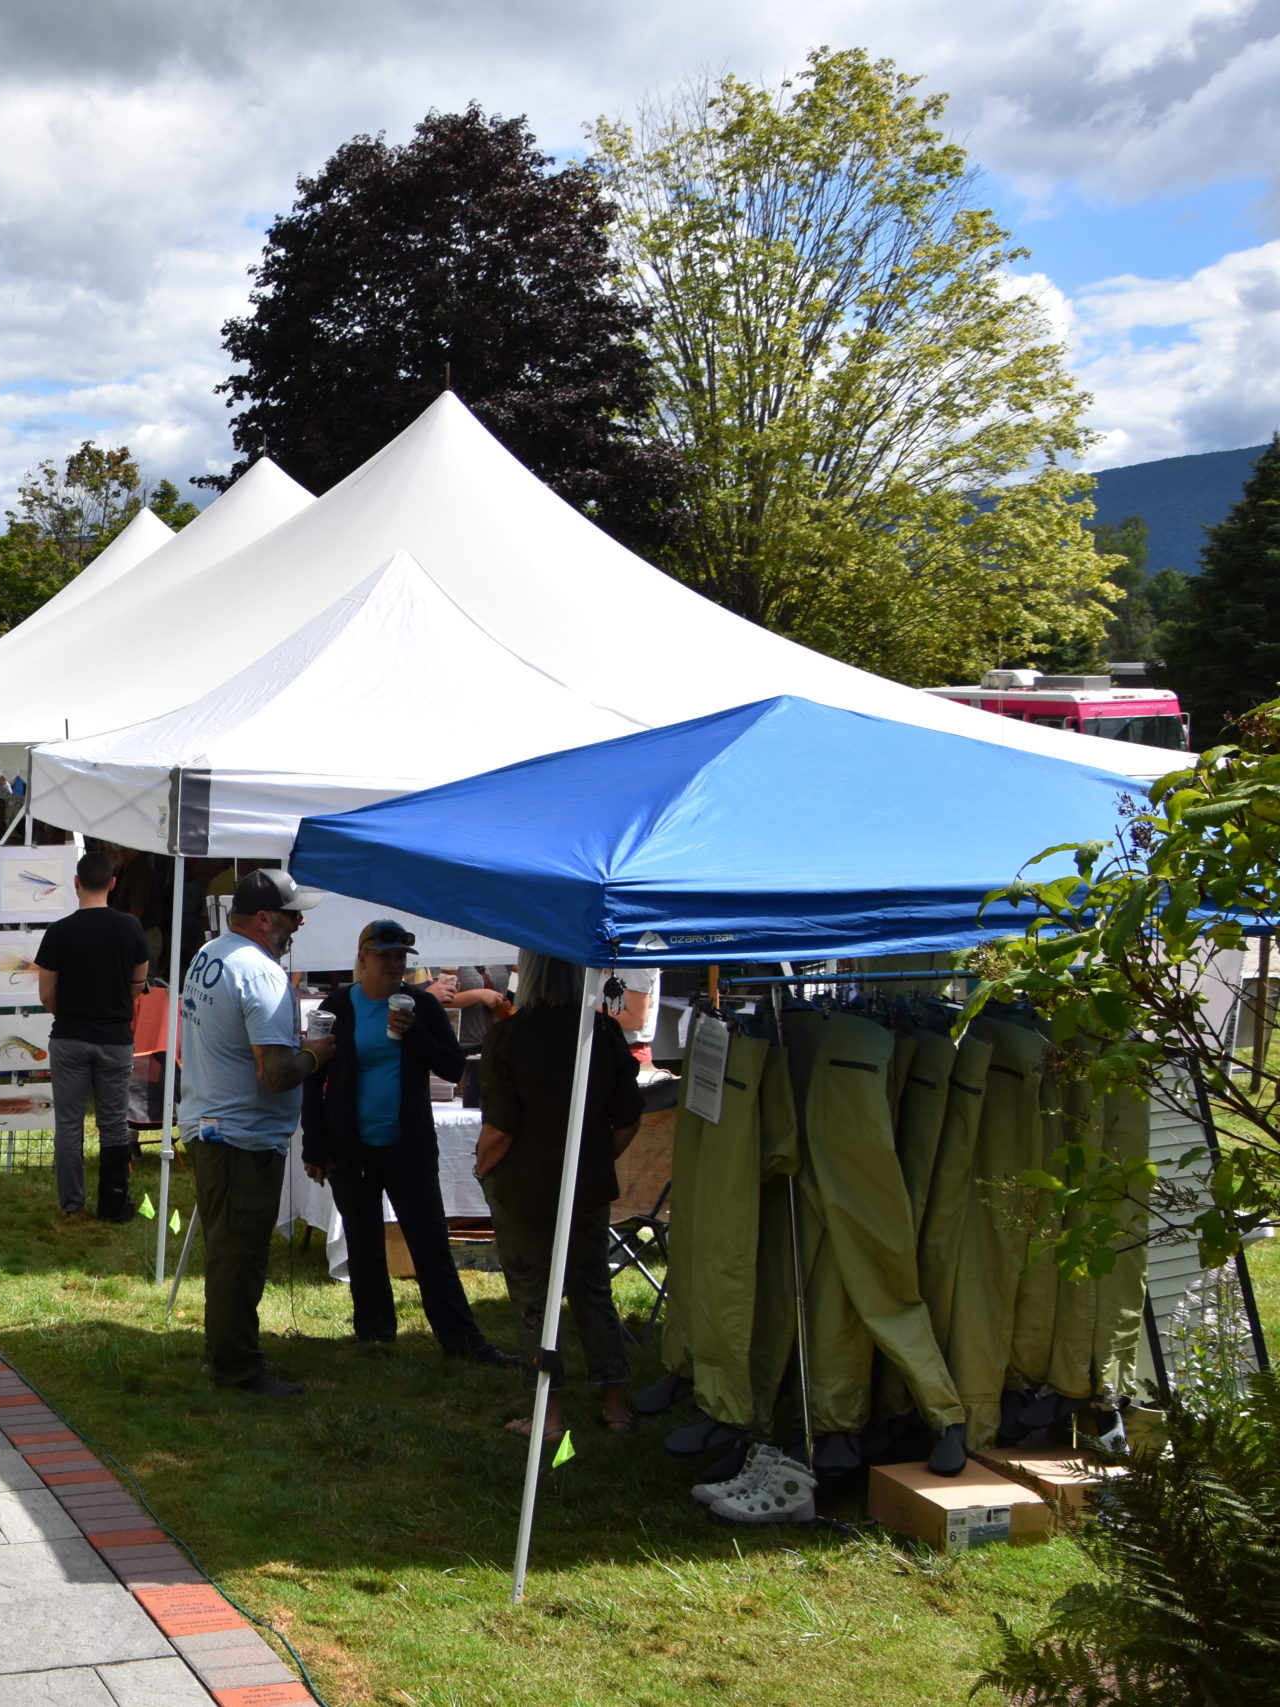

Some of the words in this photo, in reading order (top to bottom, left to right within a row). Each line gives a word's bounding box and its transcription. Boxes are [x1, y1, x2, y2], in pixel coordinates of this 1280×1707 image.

[670, 935, 706, 944] OZARK
[707, 933, 738, 943] TRAIL
[189, 951, 223, 989] RO
[949, 1530, 958, 1542] 6
